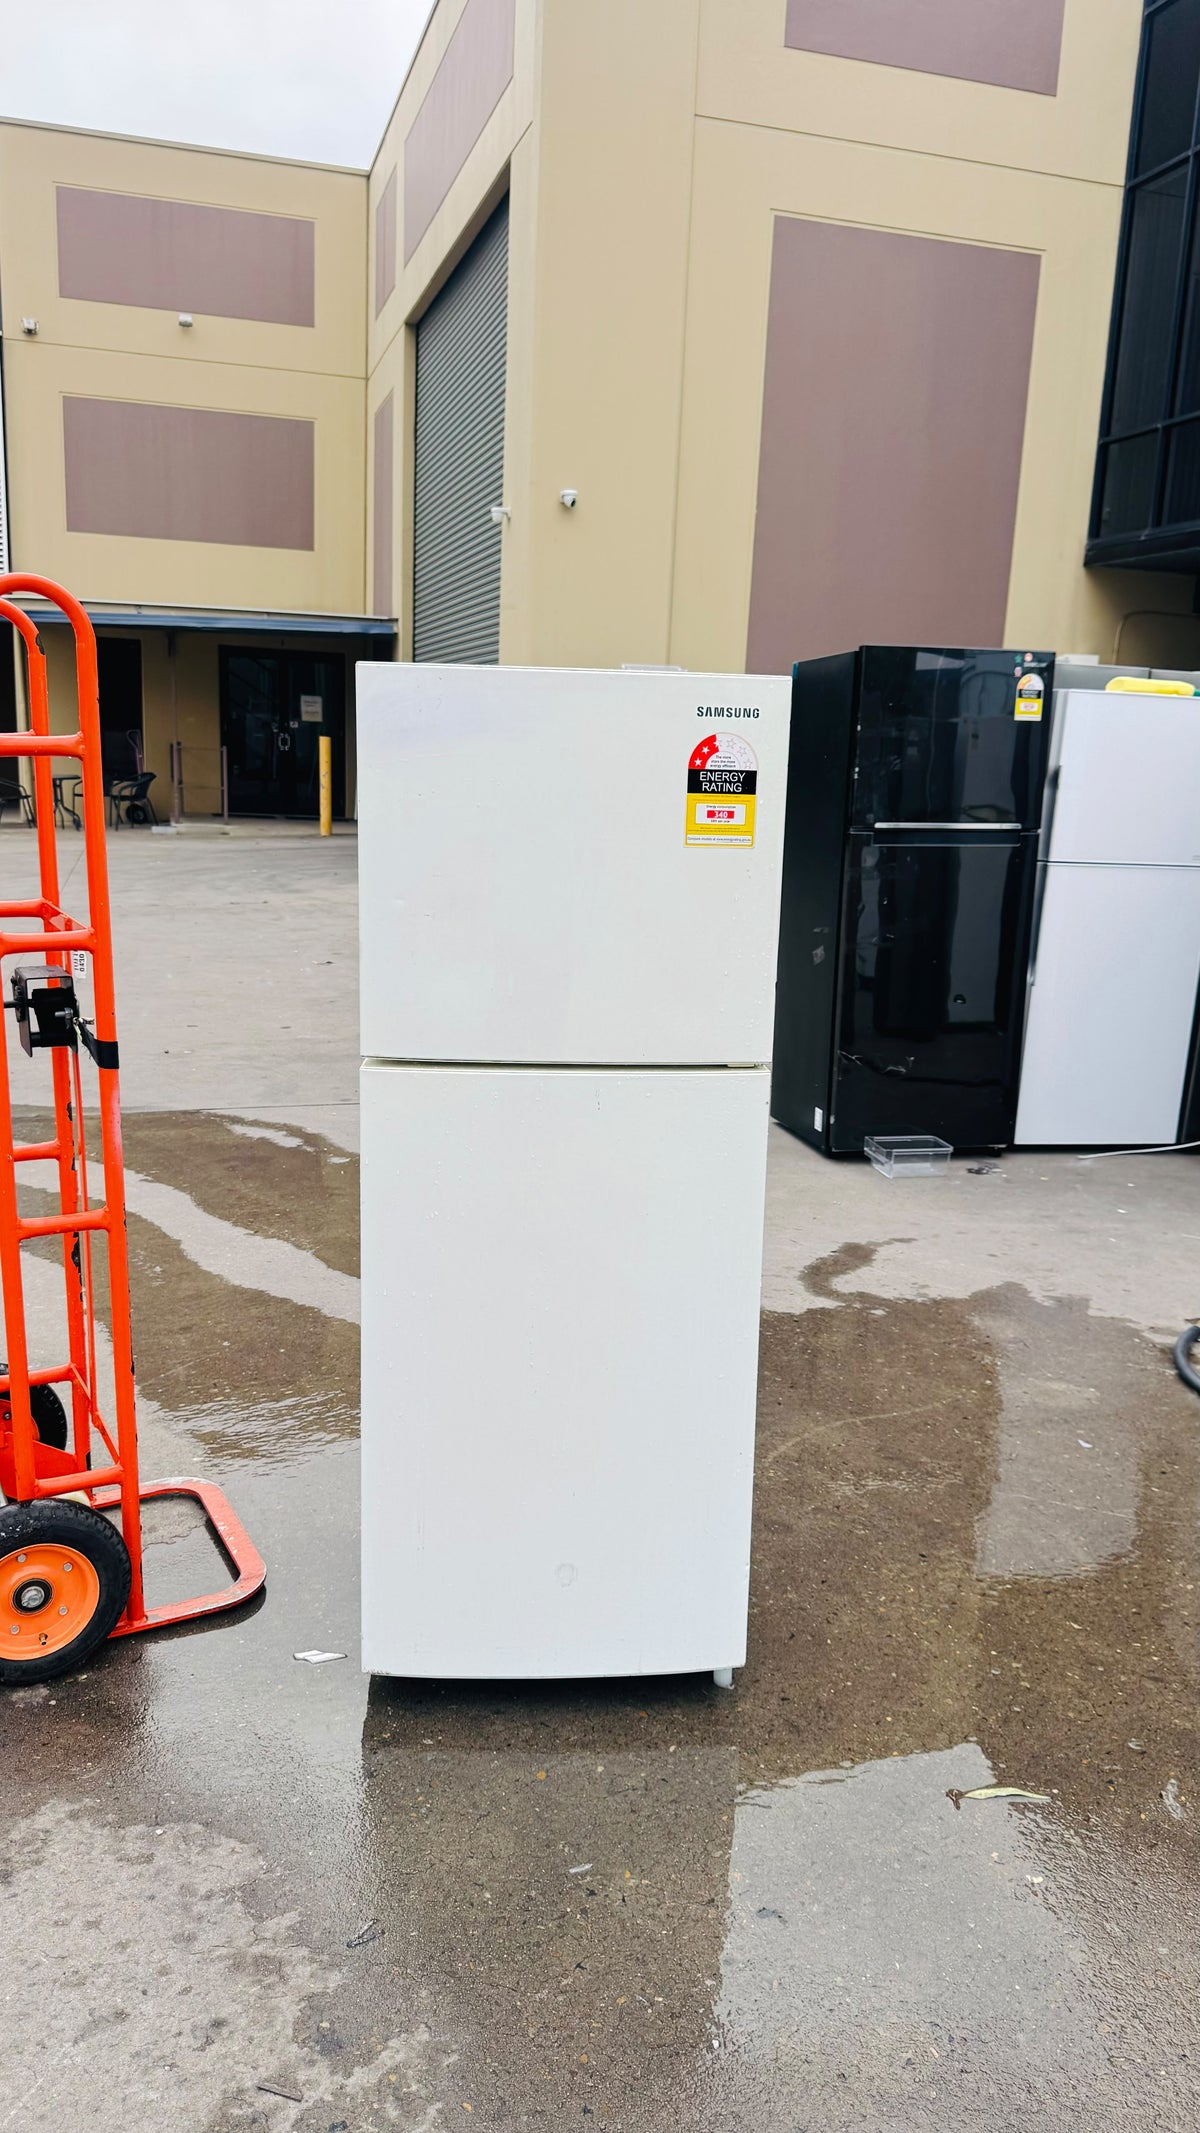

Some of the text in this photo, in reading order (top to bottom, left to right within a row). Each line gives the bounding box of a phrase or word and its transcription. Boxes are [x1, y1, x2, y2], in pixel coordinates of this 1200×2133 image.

[696, 706, 760, 719] SAMSUNG
[699, 771, 746, 782] ENERGY
[702, 782, 742, 792] RATING
